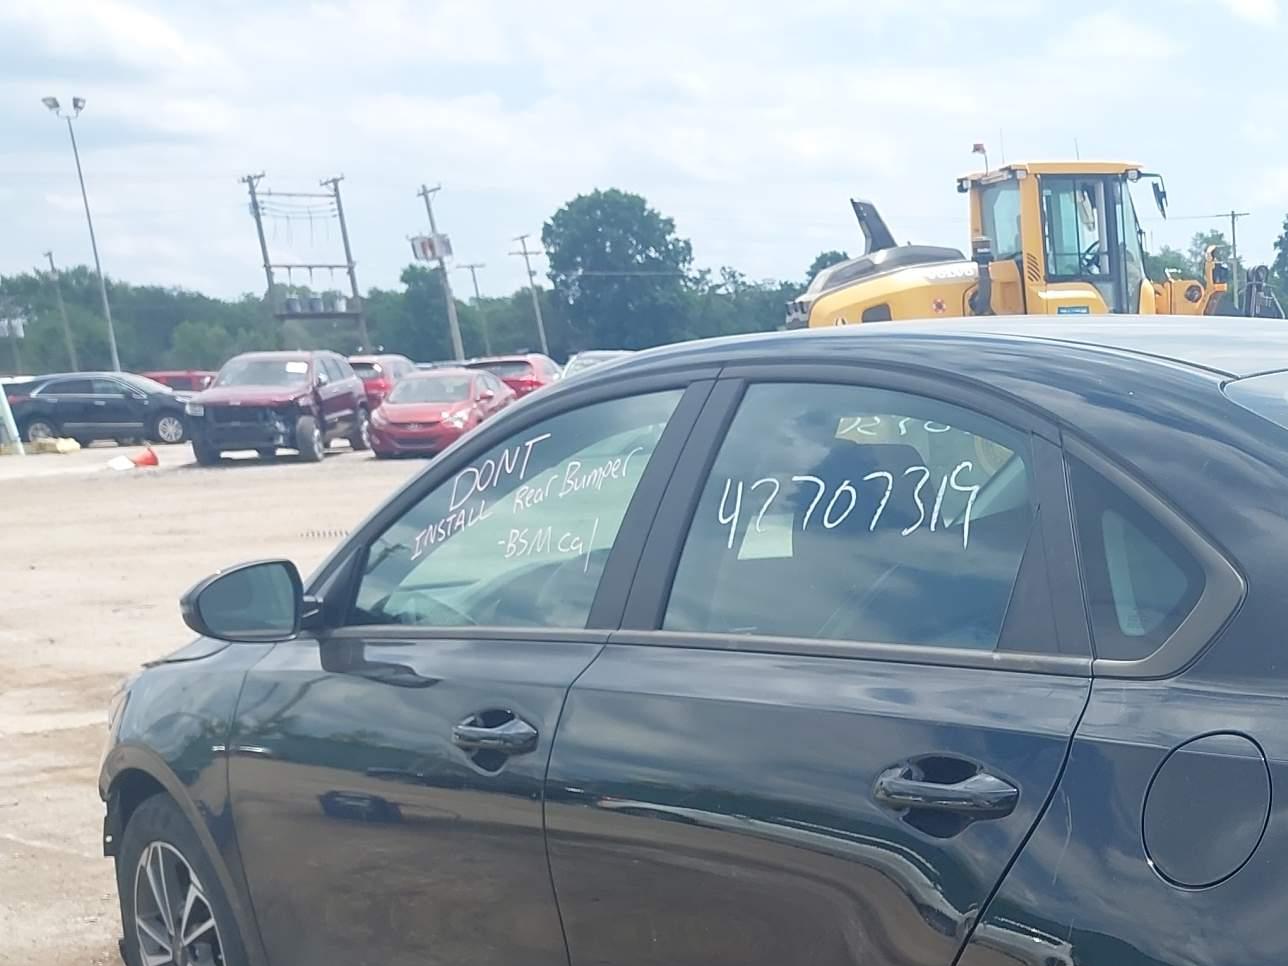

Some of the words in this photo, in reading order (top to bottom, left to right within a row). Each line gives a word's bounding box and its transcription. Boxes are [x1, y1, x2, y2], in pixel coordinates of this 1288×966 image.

[411, 501, 496, 560] INSTALL
[558, 447, 643, 498] Bumper
[449, 433, 551, 512] DONT
[718, 461, 981, 551] 42707319
